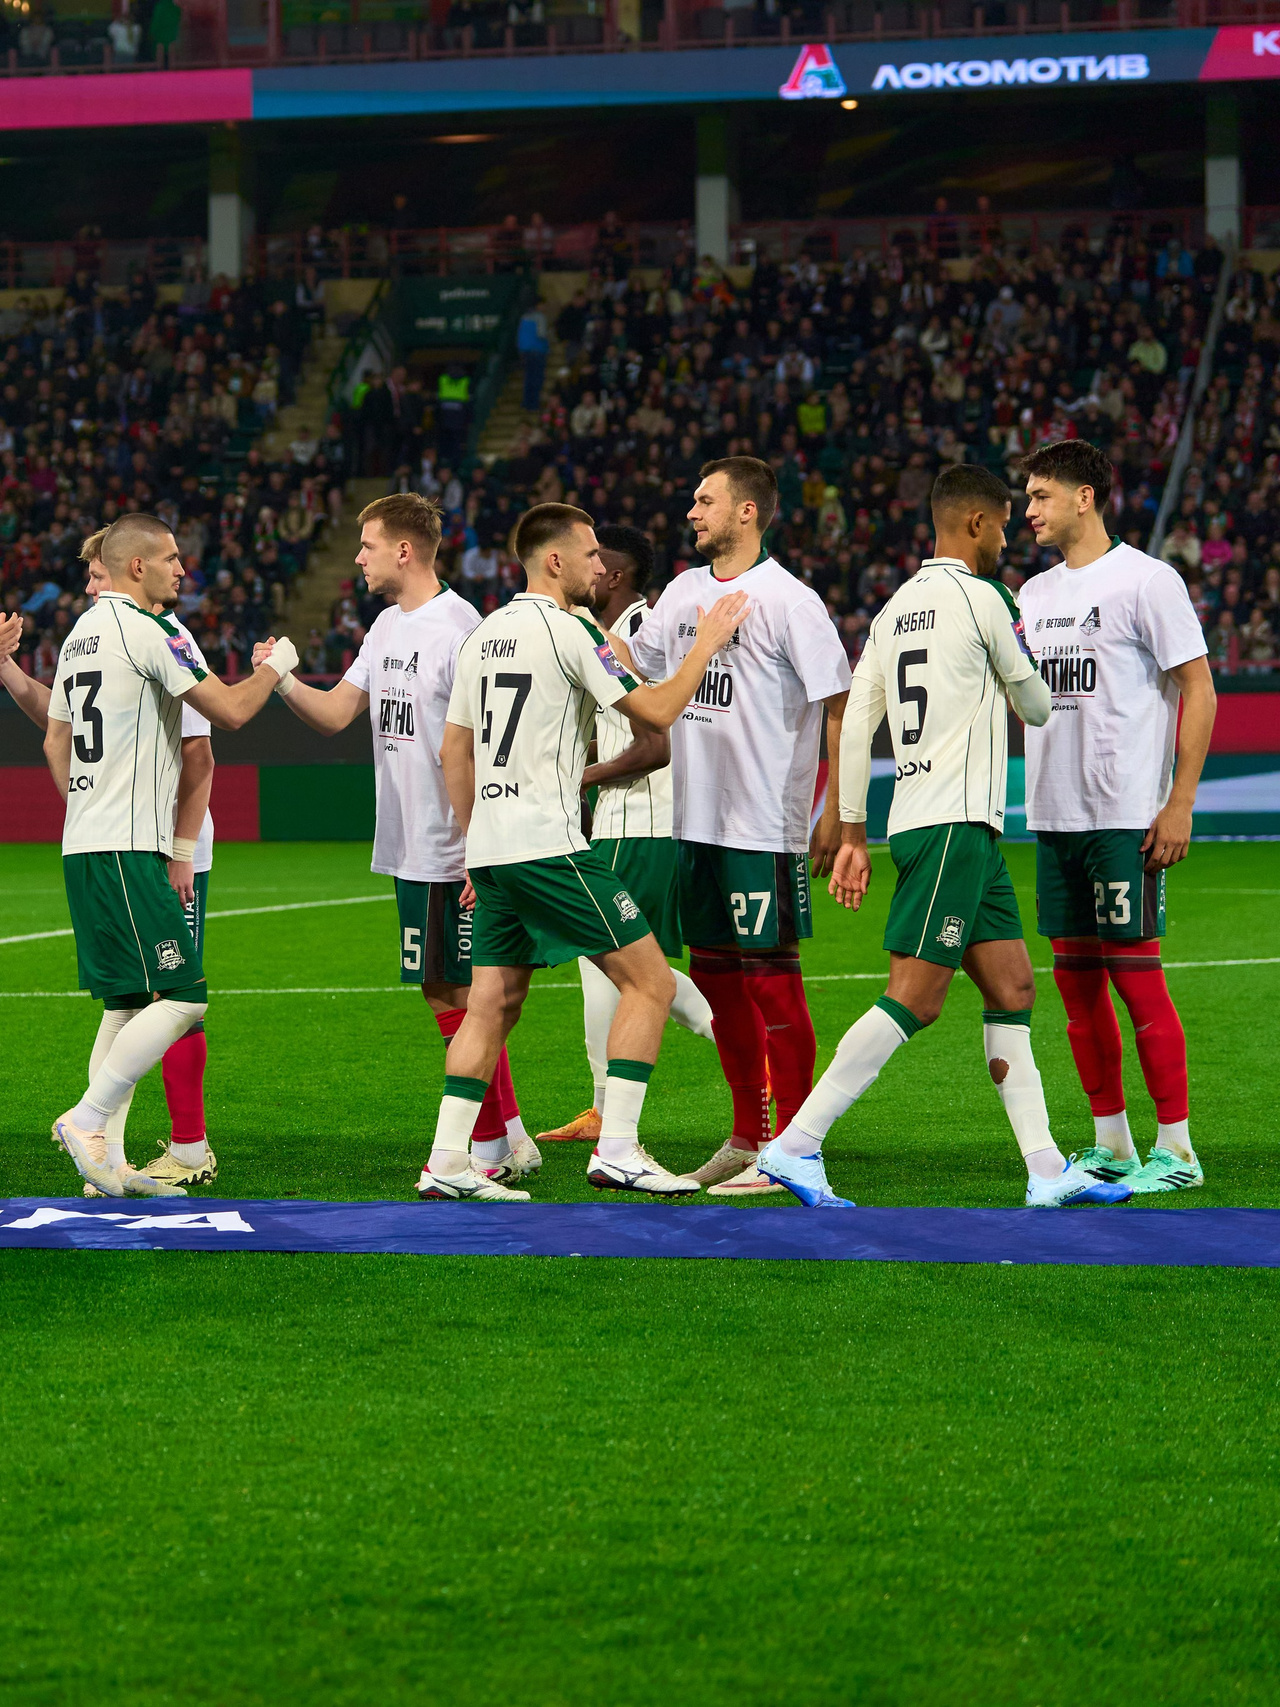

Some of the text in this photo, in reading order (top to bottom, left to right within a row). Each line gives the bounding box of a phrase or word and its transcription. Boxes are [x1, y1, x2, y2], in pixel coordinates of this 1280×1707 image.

[871, 54, 1150, 90] ЛОКОМОТИВ
[893, 609, 936, 636] ЖУБАЛ
[1046, 617, 1076, 629] BETBOOM
[1041, 644, 1080, 656] СТАНЦИЯ
[1040, 657, 1096, 692] АТИНО
[897, 648, 928, 746] 5
[69, 774, 94, 792] ZON
[730, 891, 771, 935] 27
[1094, 881, 1131, 925] 23
[403, 927, 421, 970] 5
[458, 904, 473, 962] ТОПА
